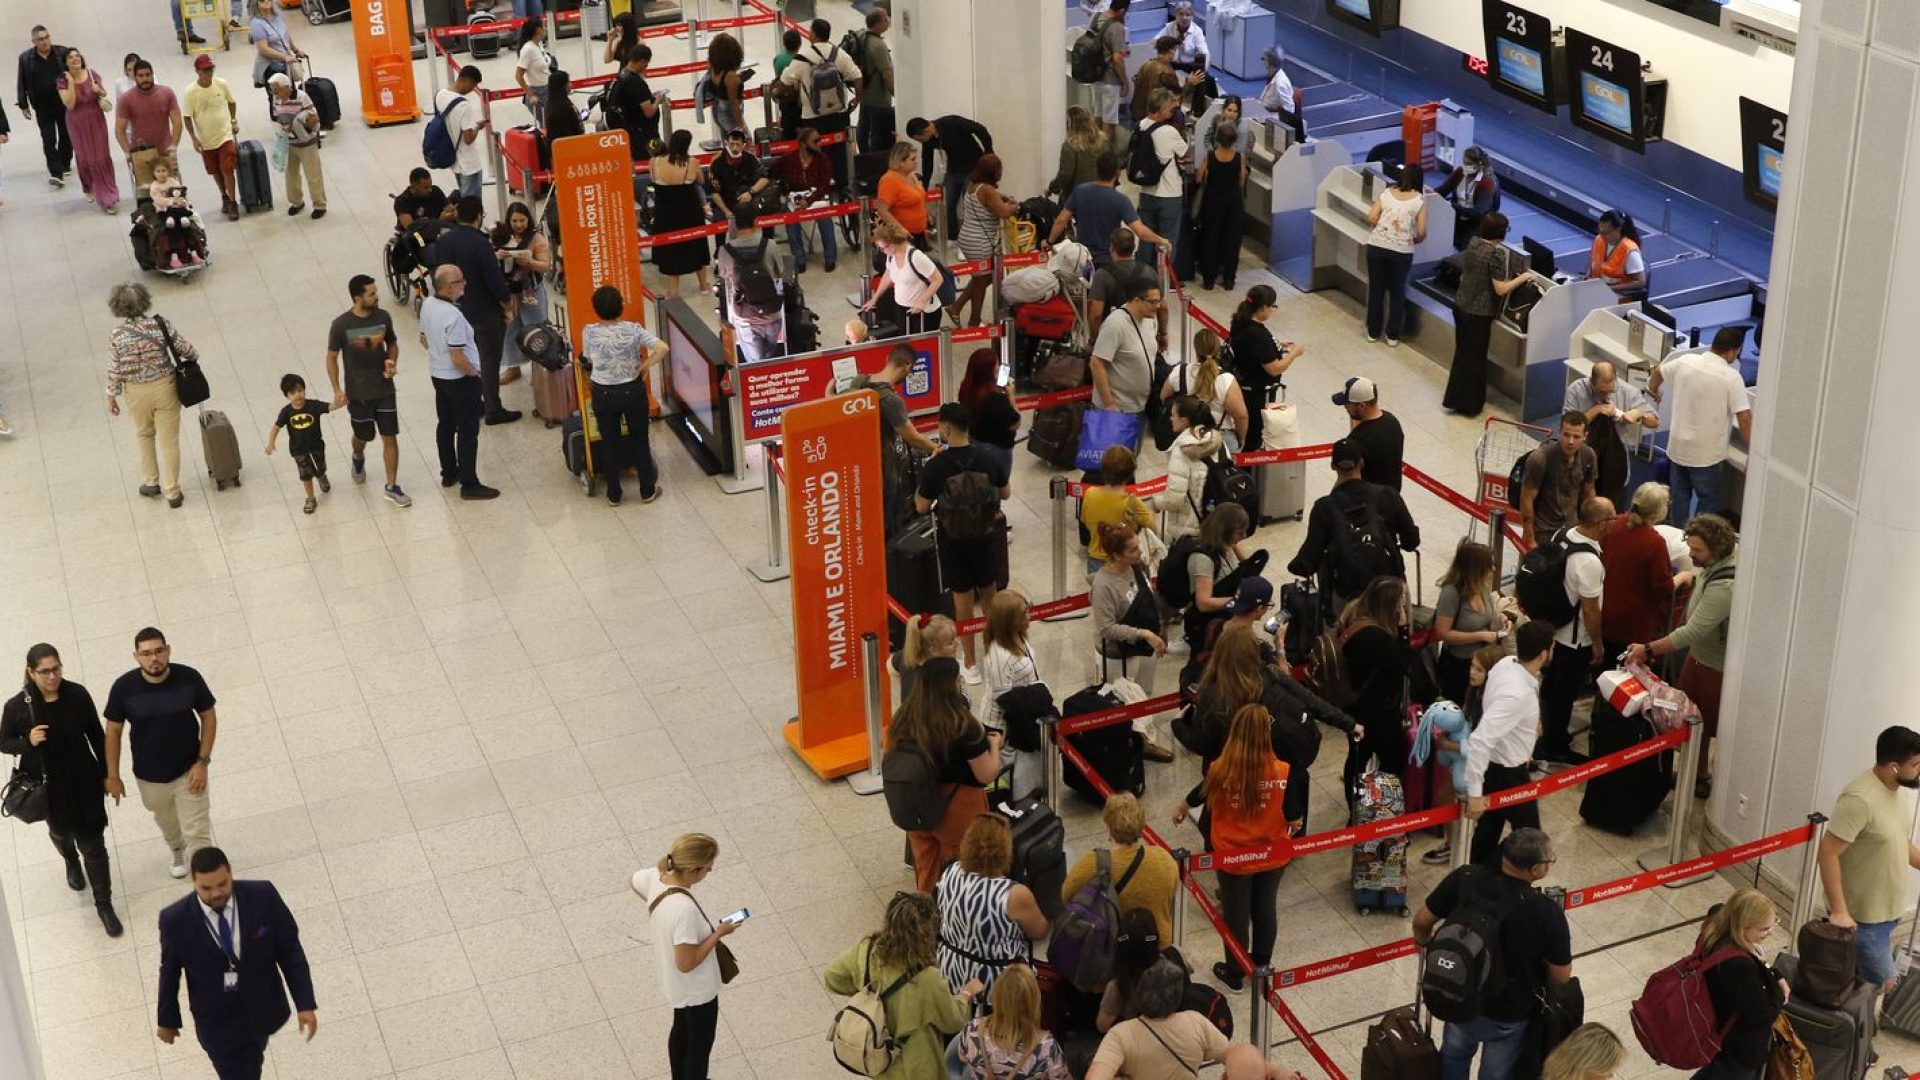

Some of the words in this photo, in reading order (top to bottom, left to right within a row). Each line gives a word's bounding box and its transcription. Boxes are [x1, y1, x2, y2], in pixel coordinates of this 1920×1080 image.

[1506, 11, 1527, 36] 23
[1591, 45, 1615, 72] 24
[599, 134, 627, 148] GOL
[1770, 118, 1786, 143] 2
[584, 184, 595, 200] LEI
[586, 202, 596, 228] POR
[588, 230, 603, 288] FERENCIAL
[842, 395, 876, 415] GOL
[802, 476, 819, 545] check-in
[820, 470, 843, 580] ORLANDO
[826, 583, 844, 599] E
[826, 601, 847, 670] MIAMI
[1223, 851, 1269, 865] HotMilhas
[1293, 841, 1316, 851] Vende
[1317, 838, 1332, 846] suas
[1333, 833, 1356, 843] milhas
[1305, 960, 1350, 978] HotMilhas
